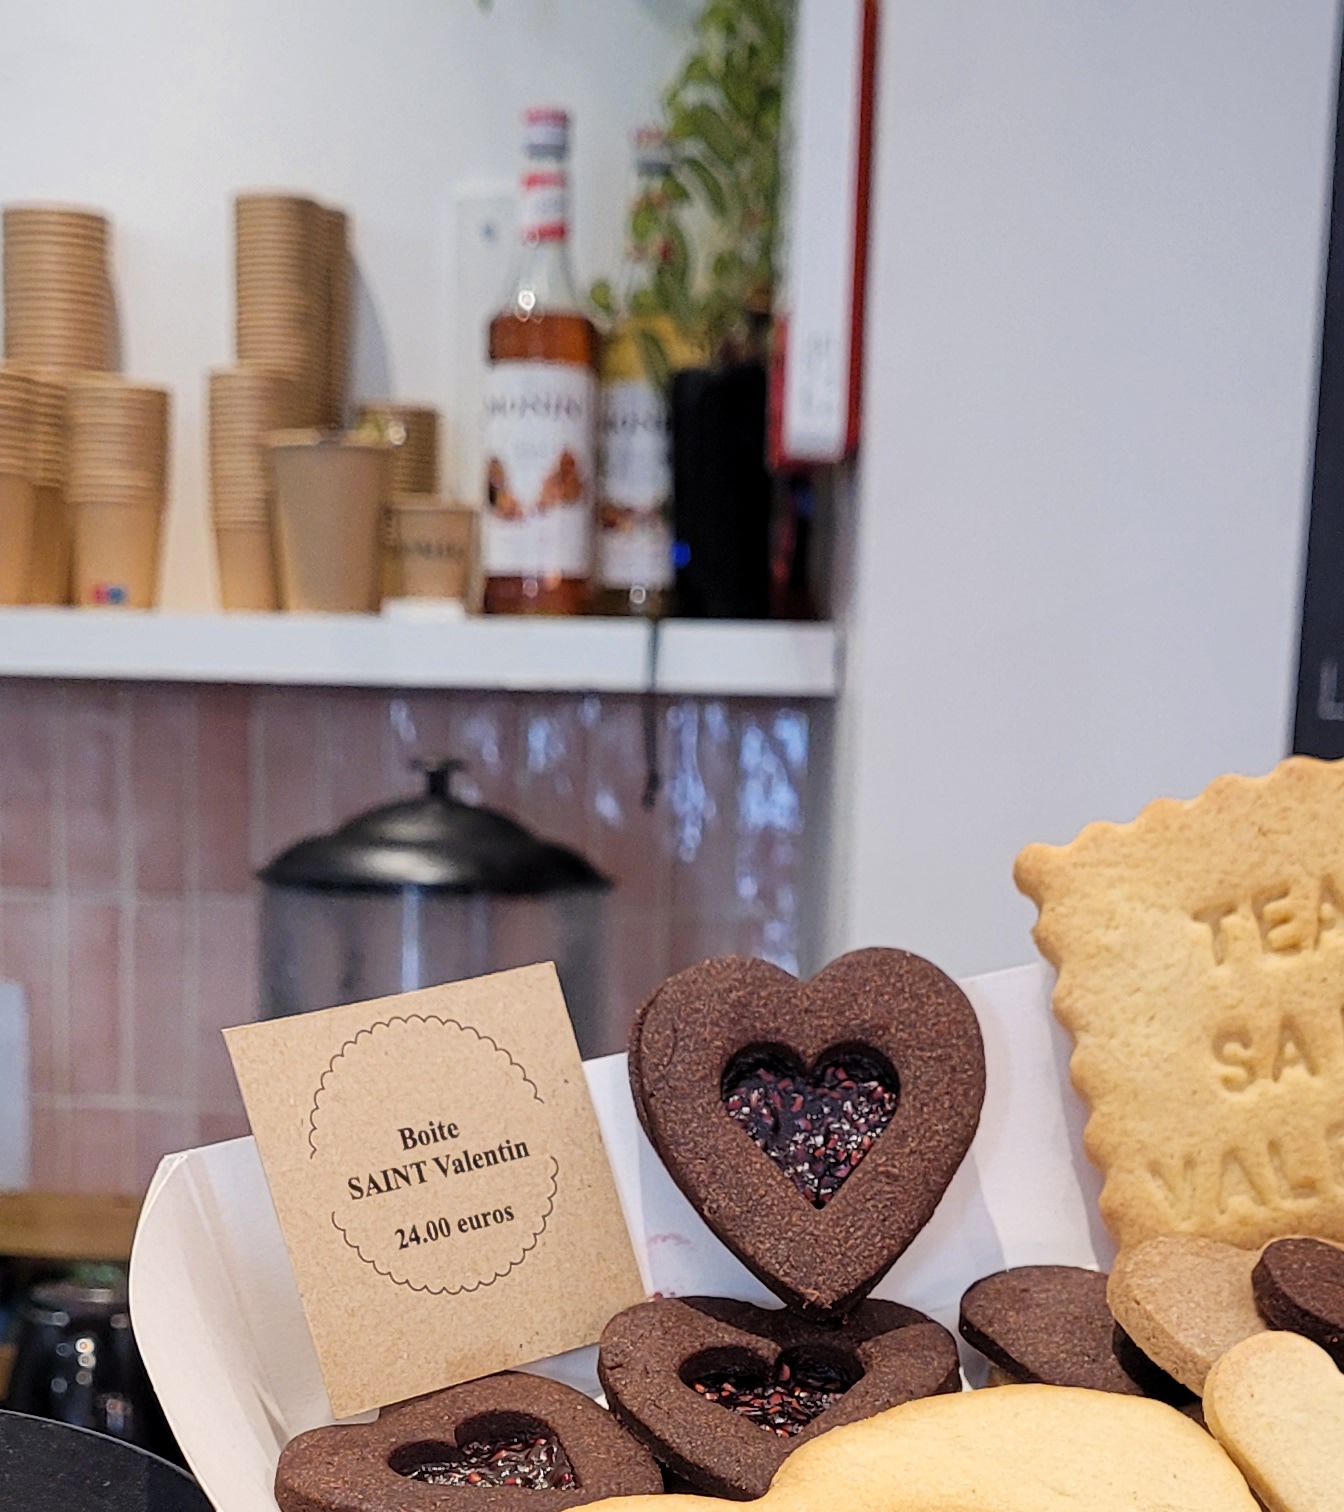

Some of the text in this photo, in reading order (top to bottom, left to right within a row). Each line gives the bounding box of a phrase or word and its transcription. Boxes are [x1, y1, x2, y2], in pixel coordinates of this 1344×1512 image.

[397, 1120, 460, 1150] Boite
[347, 1139, 530, 1201] SAINT Valentin
[394, 1205, 515, 1250] 24.00 euros
